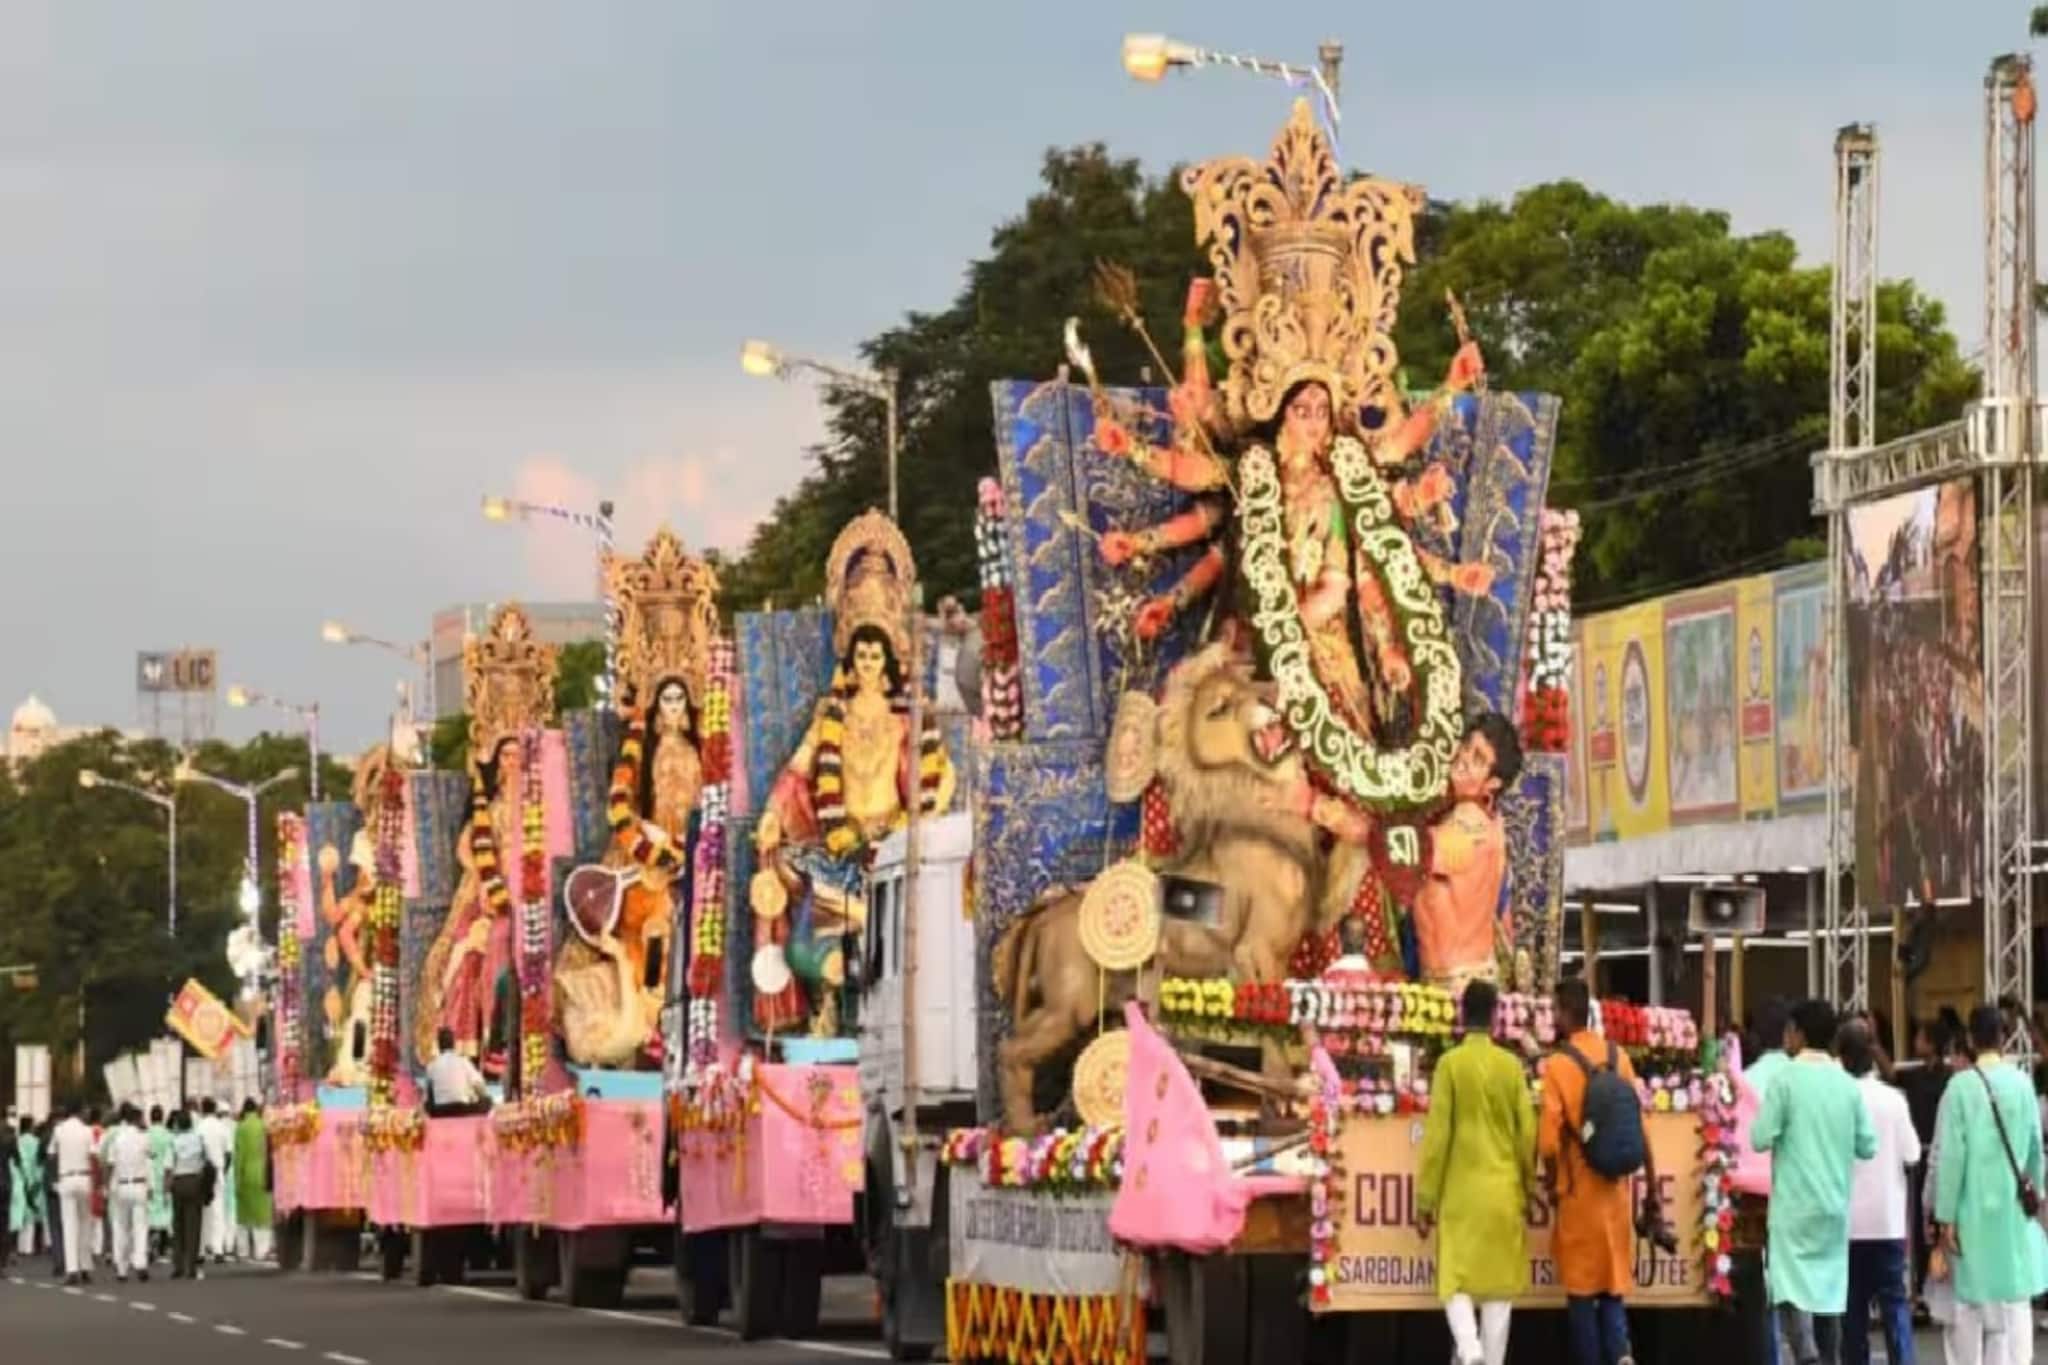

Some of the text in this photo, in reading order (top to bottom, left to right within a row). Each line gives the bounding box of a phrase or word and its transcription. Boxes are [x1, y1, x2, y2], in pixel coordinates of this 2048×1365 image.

[174, 656, 211, 688] LIC
[1355, 1173, 1419, 1227] COL
[1340, 1255, 1436, 1285] SARBOJAN
